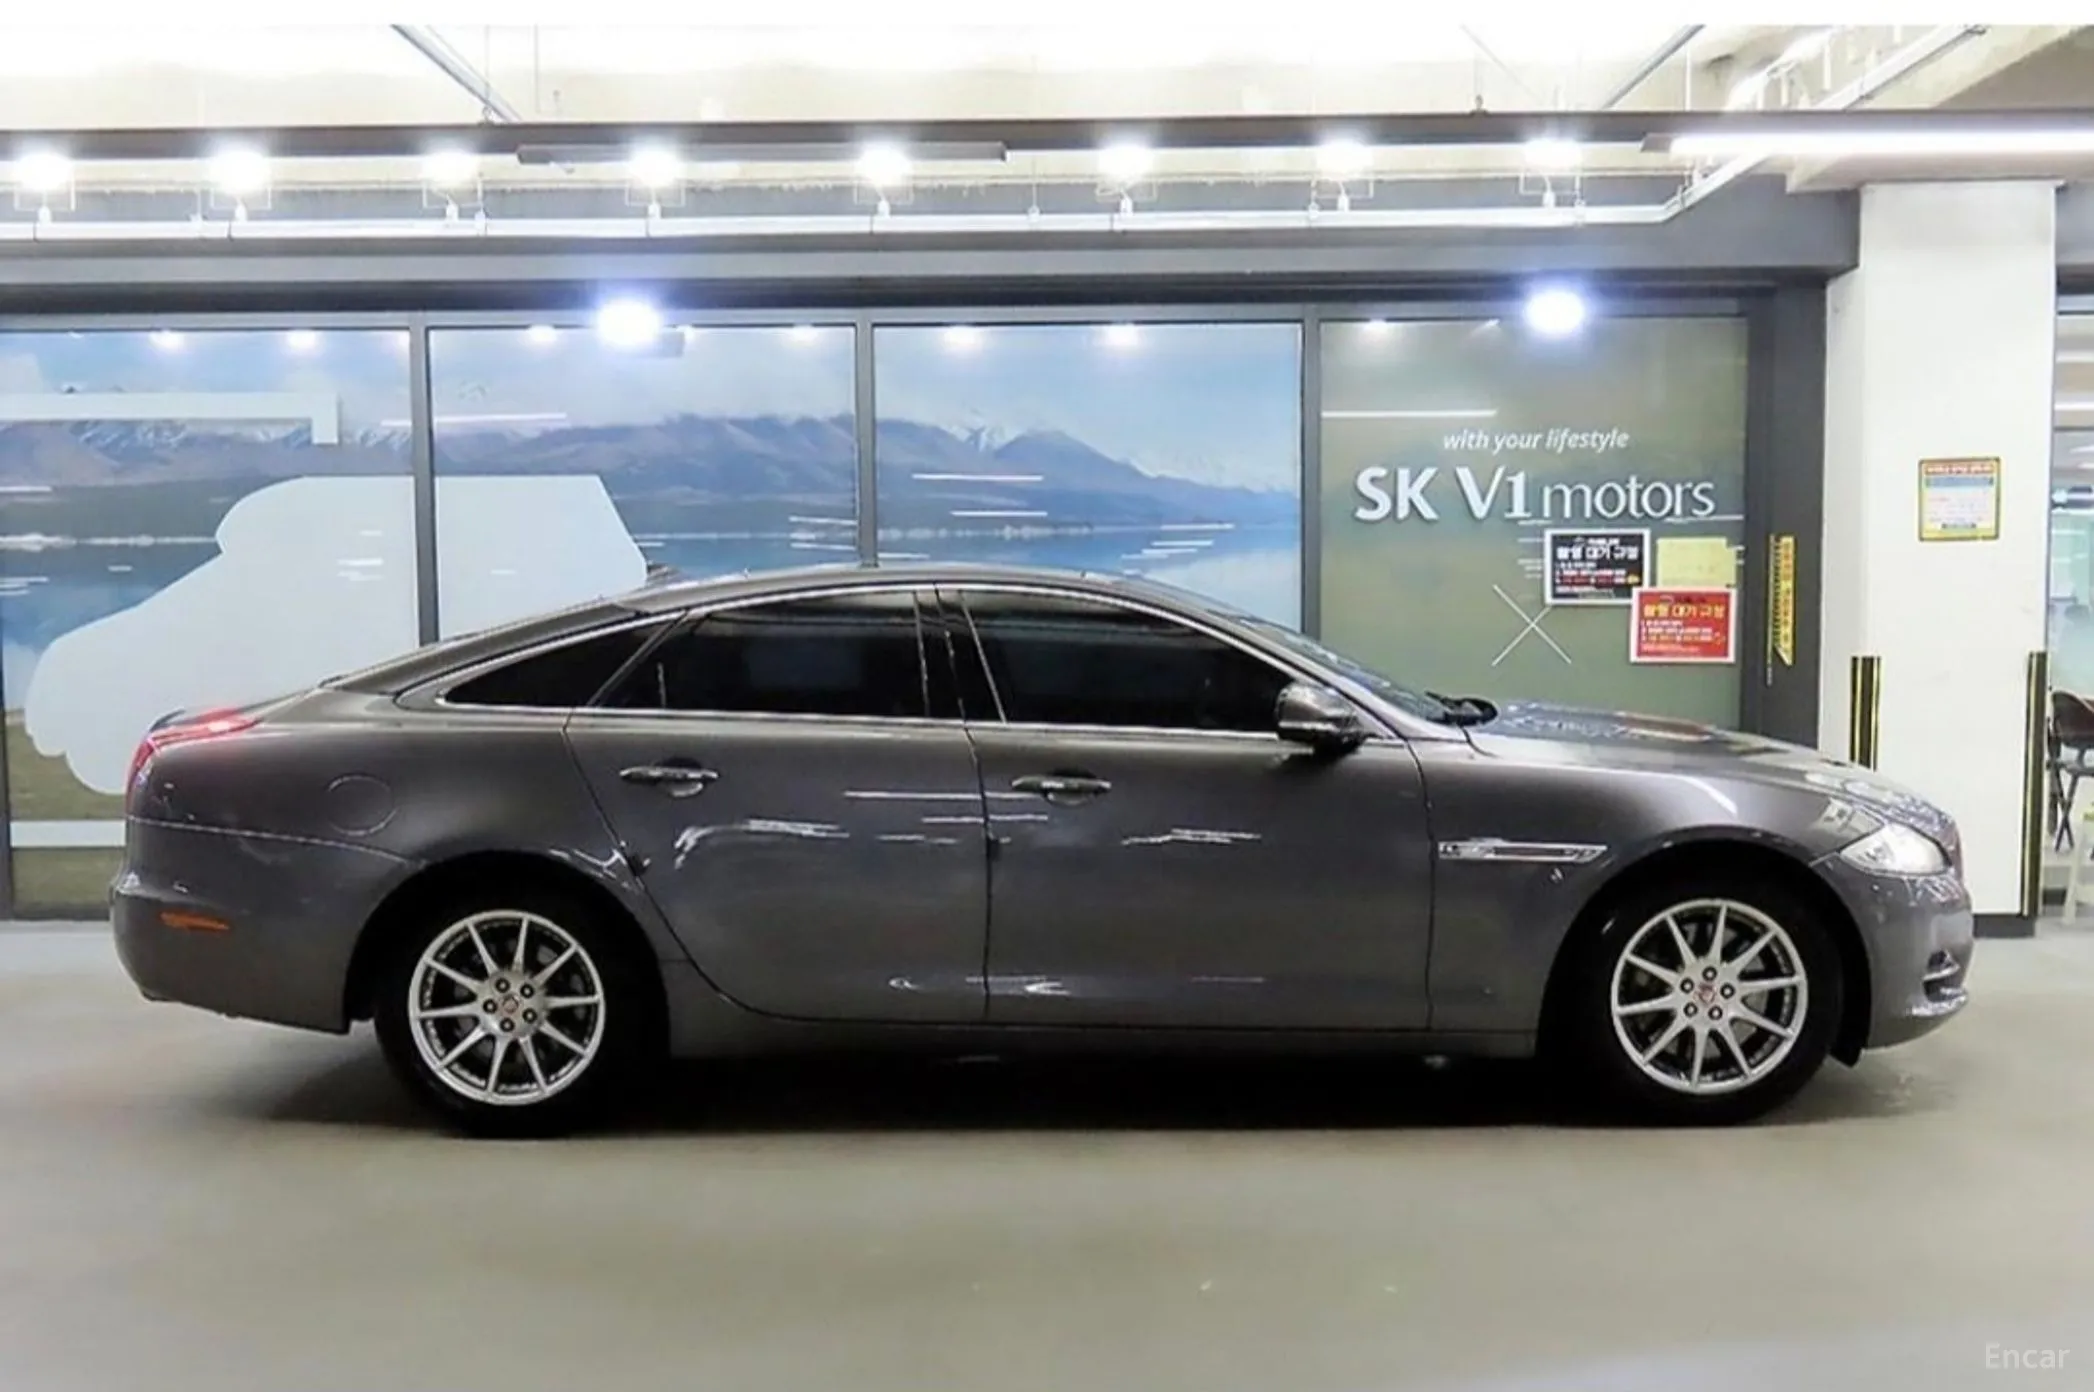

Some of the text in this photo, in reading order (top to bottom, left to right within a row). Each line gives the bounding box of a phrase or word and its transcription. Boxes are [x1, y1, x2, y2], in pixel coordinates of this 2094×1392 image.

[1443, 428, 1630, 455] with your lifestyle
[1354, 466, 1716, 521] SK V1 motors
